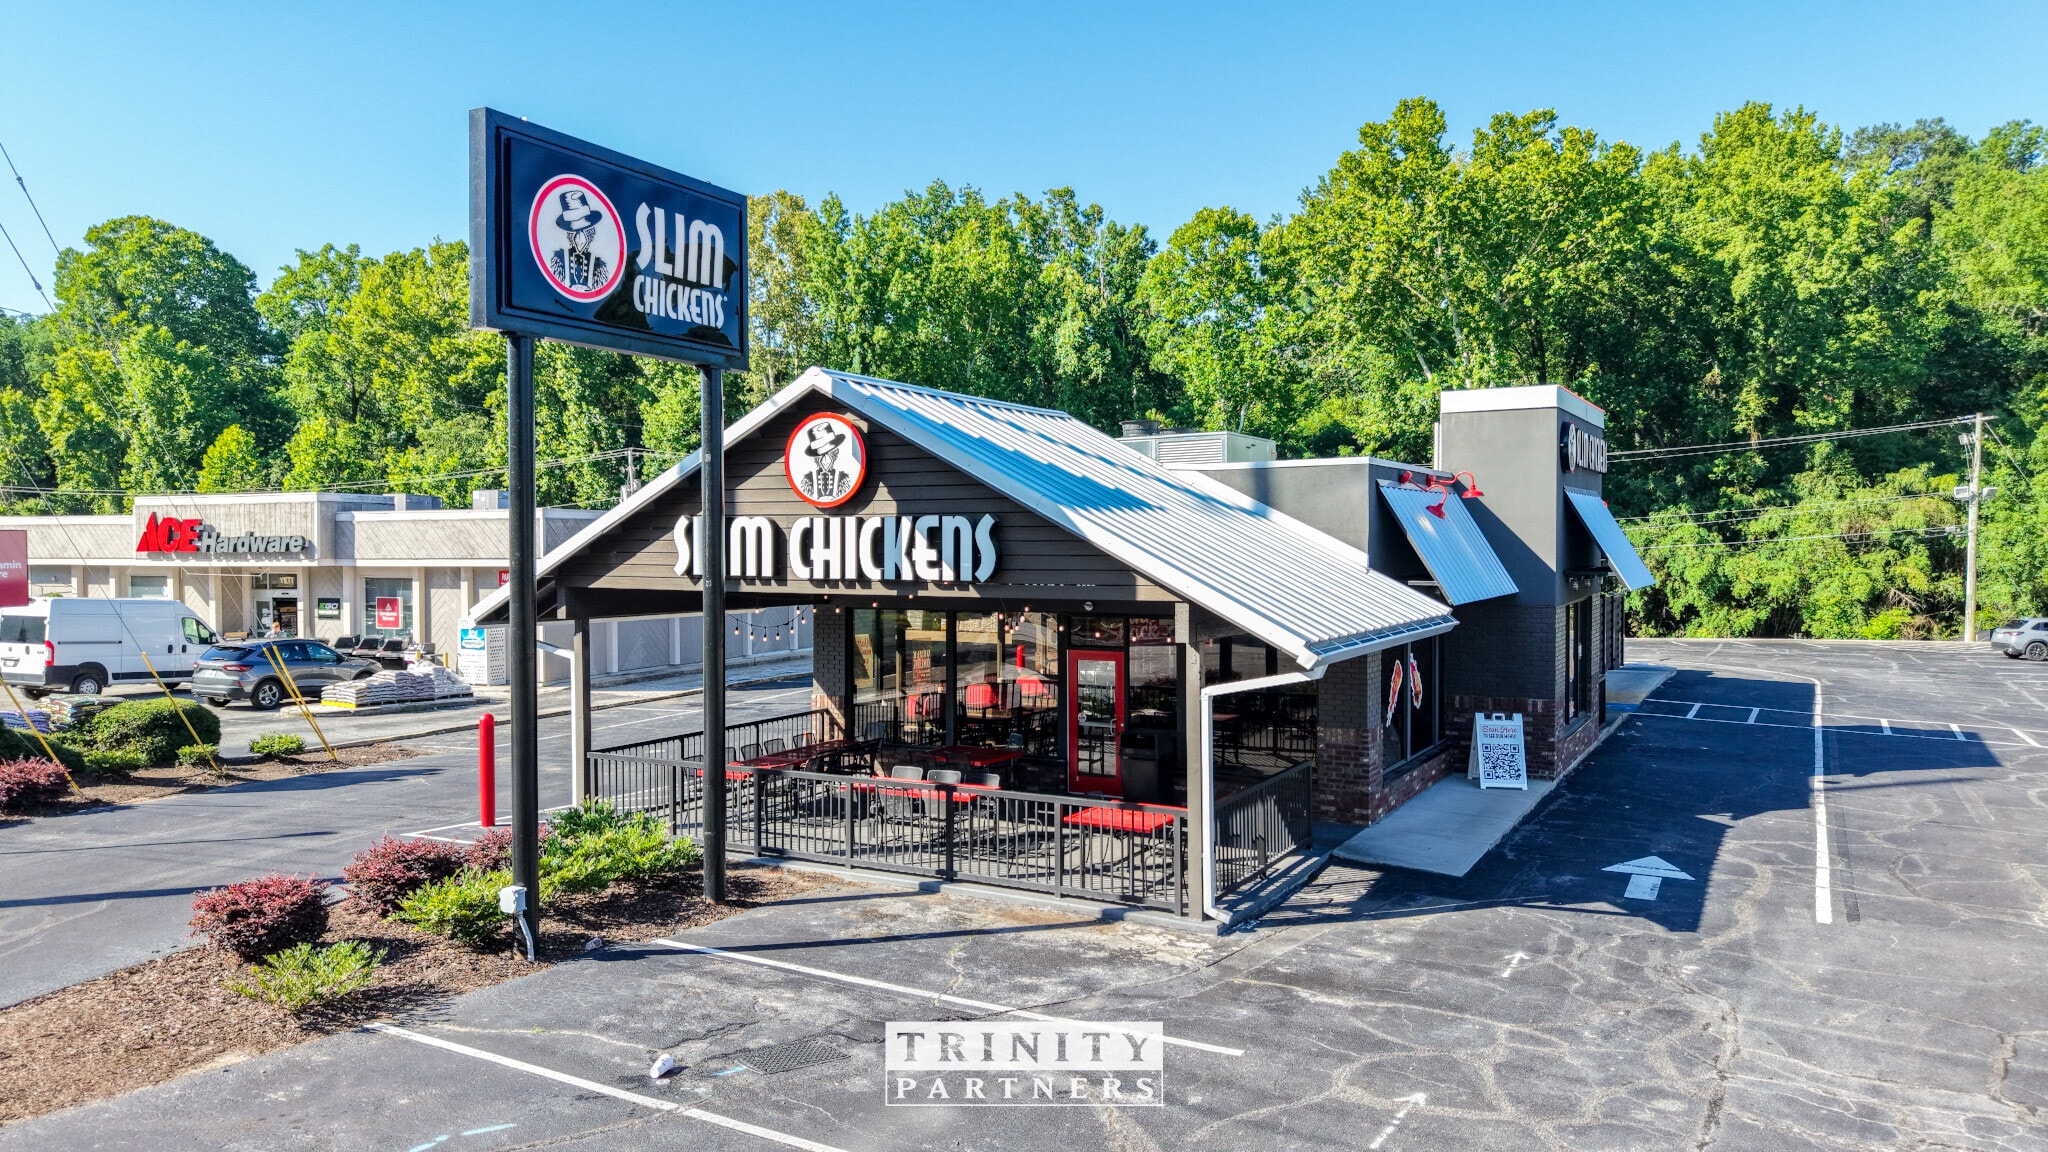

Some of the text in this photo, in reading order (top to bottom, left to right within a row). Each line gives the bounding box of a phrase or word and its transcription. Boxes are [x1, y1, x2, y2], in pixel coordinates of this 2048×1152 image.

[635, 201, 725, 289] SLIM
[633, 275, 725, 331] CHICKENS
[136, 511, 304, 553] ACE Hardware
[789, 513, 997, 583] CHICKENS
[1482, 725, 1517, 734] Scan Here
